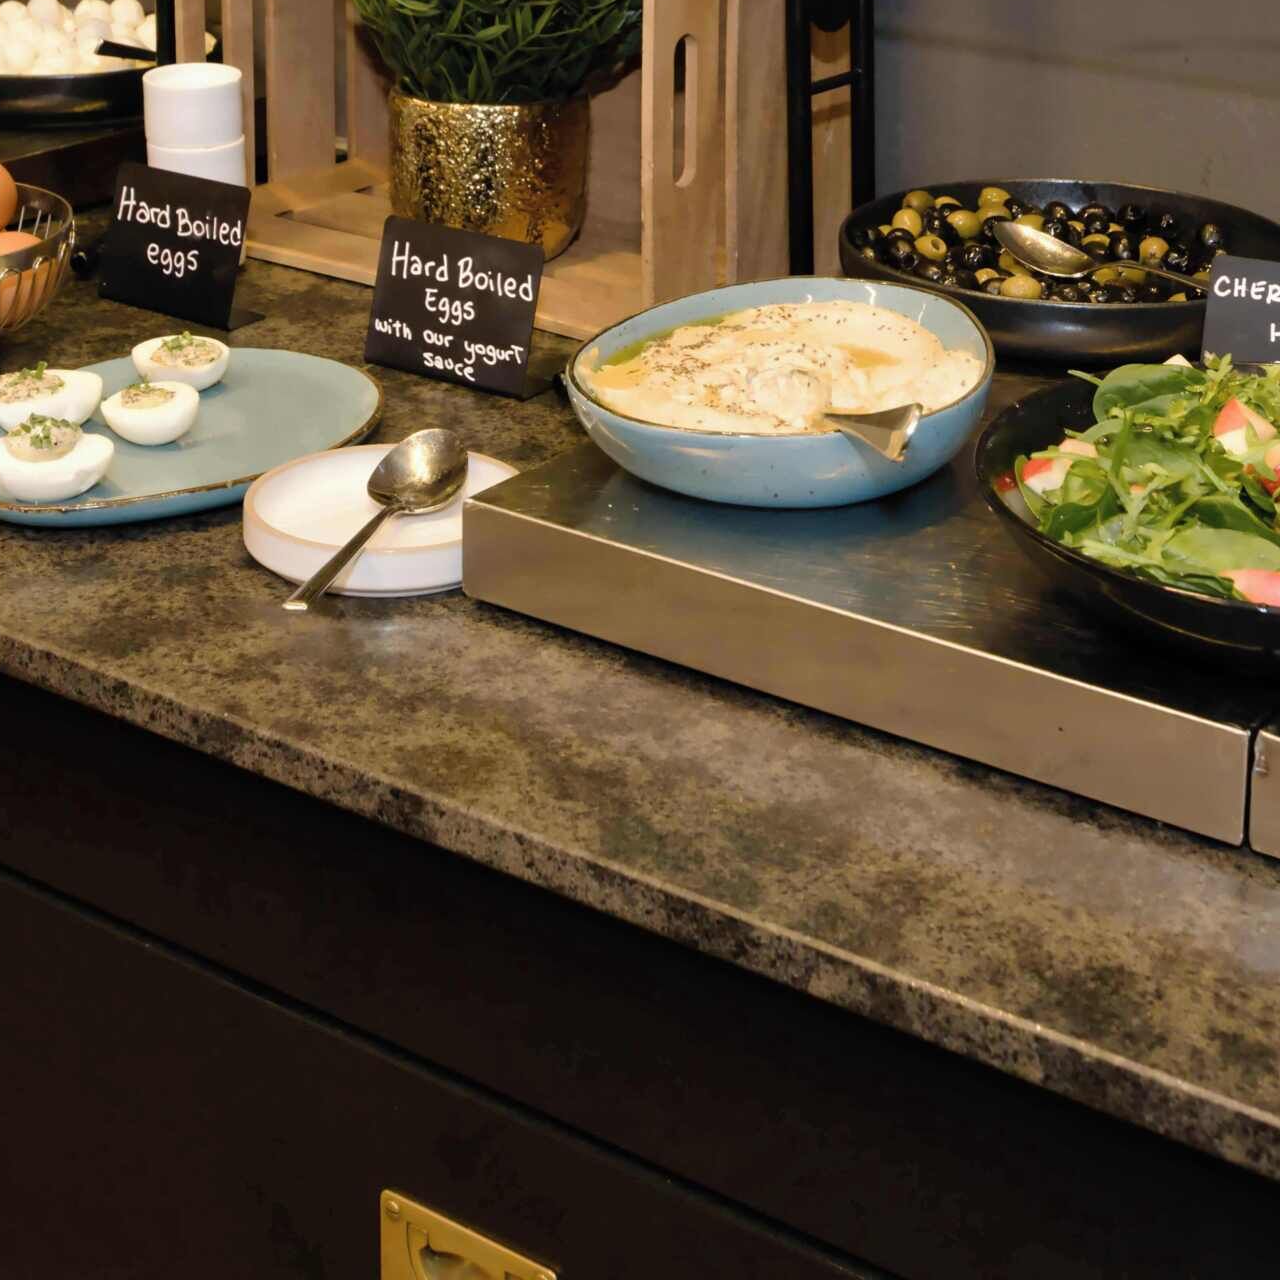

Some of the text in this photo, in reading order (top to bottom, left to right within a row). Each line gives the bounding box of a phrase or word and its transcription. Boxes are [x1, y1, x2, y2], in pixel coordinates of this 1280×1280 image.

[117, 185, 242, 246] Hard Boiled
[147, 243, 200, 278] eggs
[391, 240, 534, 302] Hard Boiled
[425, 288, 476, 326] Eggs
[375, 318, 413, 341] with
[423, 329, 454, 348] our
[422, 352, 476, 382] sauce
